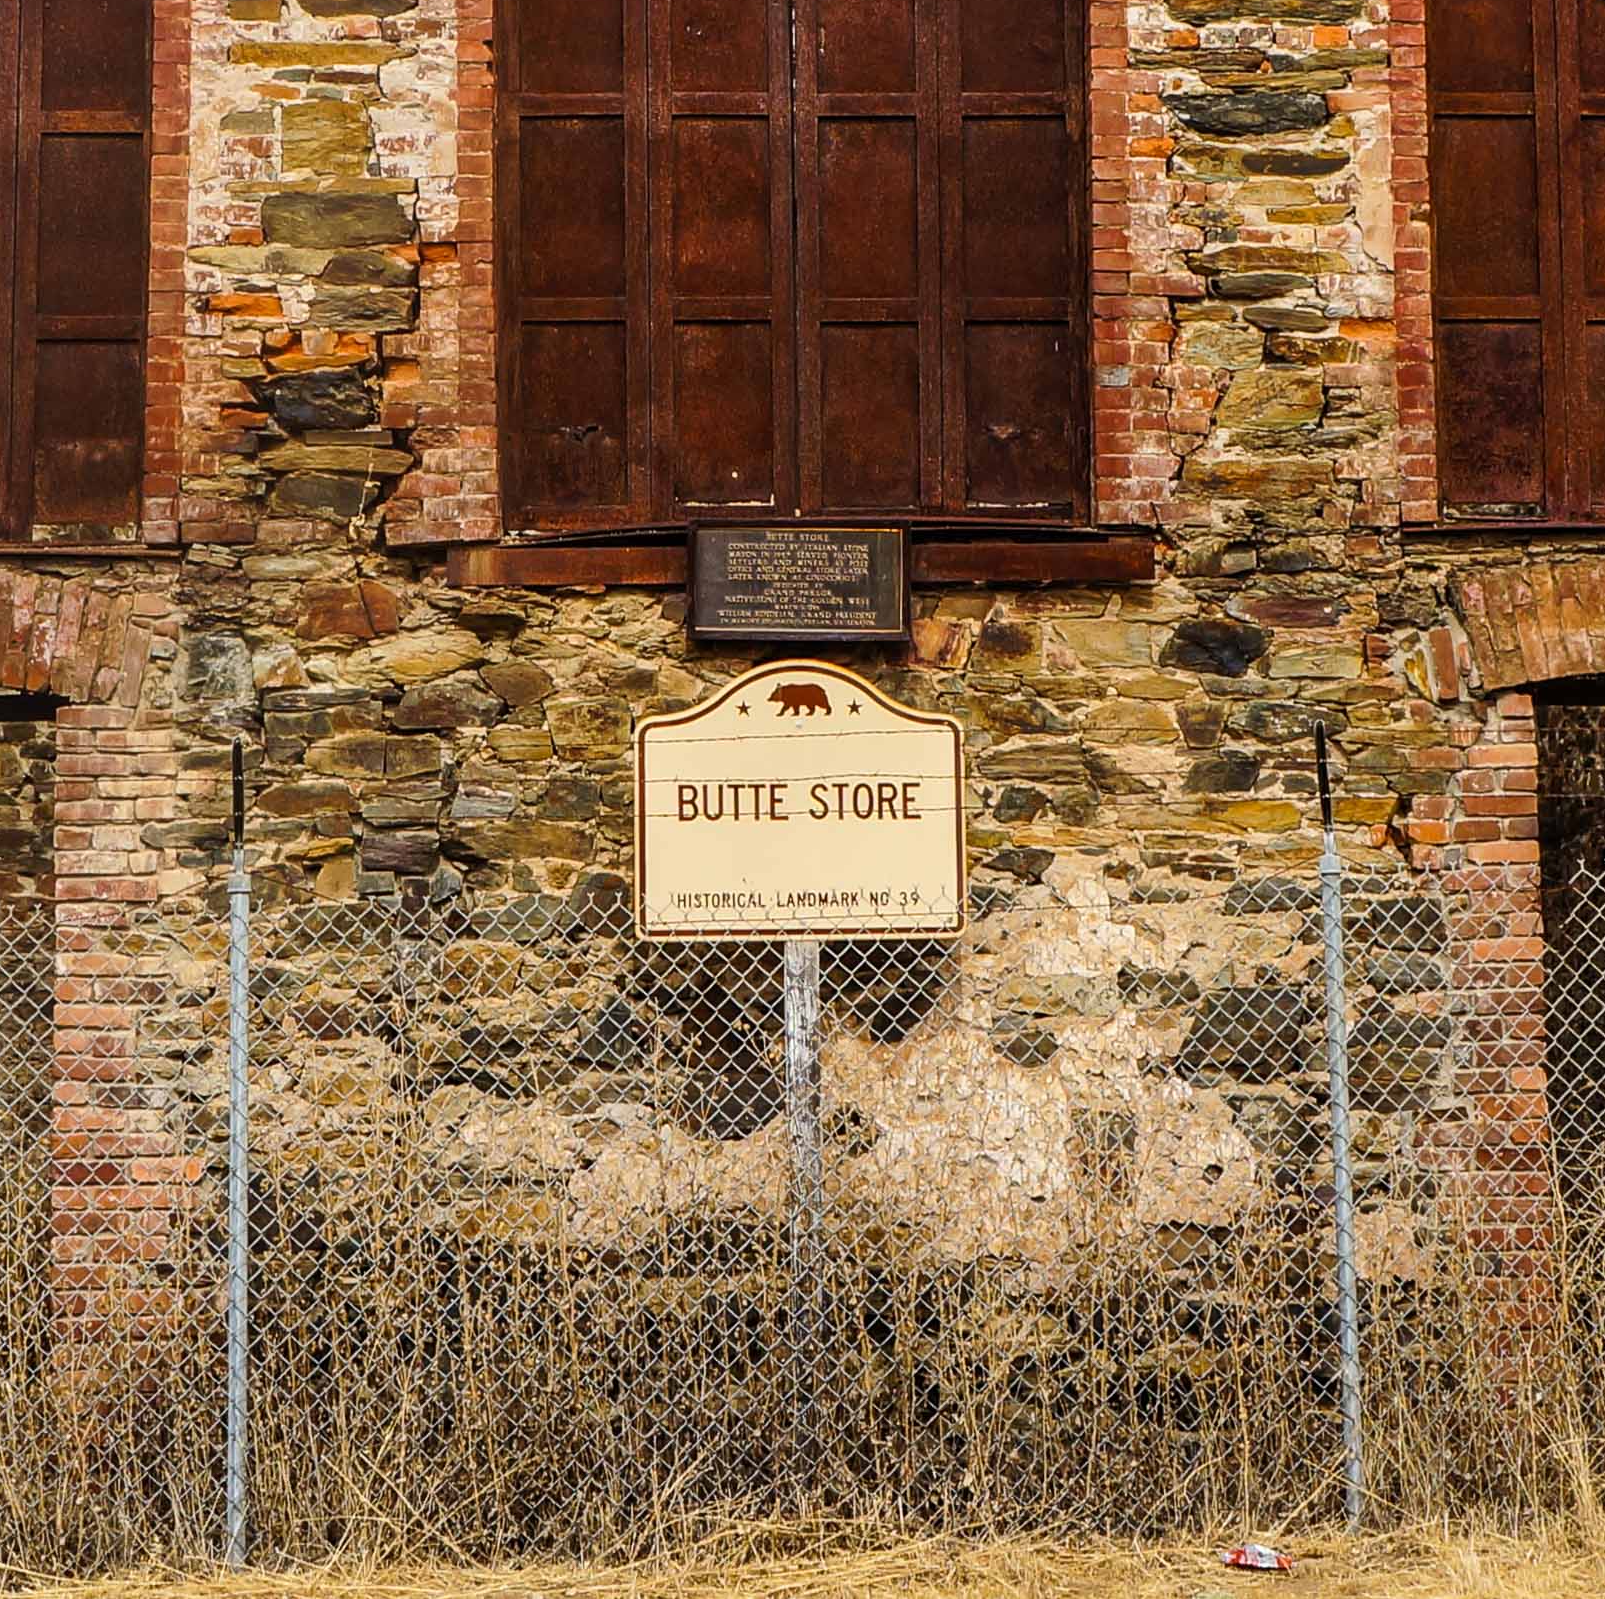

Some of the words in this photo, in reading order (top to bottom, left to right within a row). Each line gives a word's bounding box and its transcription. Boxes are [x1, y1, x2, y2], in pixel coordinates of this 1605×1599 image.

[804, 544, 838, 552] ITALIAN
[677, 784, 789, 821] BUTTE
[809, 783, 922, 820] STORE
[677, 892, 766, 908] HISTORICAL
[776, 891, 859, 908] LANDMARK
[899, 891, 920, 907] 39
